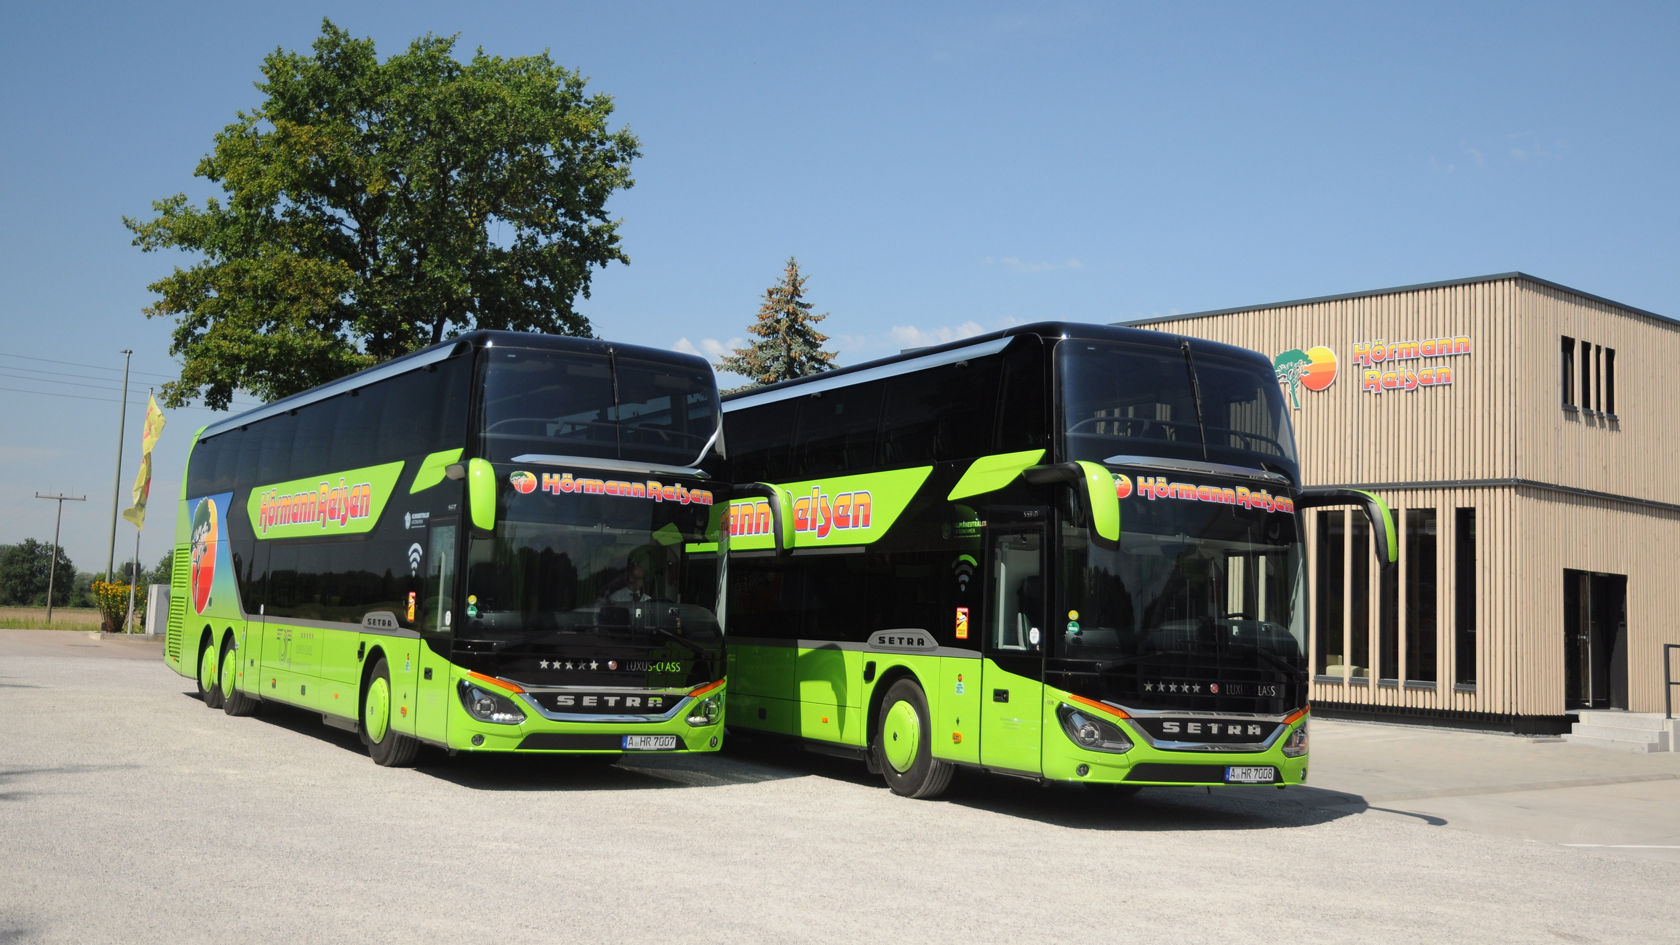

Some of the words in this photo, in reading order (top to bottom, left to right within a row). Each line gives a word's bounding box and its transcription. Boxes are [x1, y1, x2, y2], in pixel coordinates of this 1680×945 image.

[1352, 335, 1471, 367] Hörmann
[1363, 365, 1452, 394] Reisen
[542, 472, 646, 498] Hörmann
[647, 480, 713, 505] Reisen
[1137, 475, 1236, 505] Hörmann
[1236, 486, 1295, 514] Reisen
[259, 488, 318, 534] Hörmann
[317, 478, 371, 529] Reisen
[785, 485, 872, 539] eisen
[367, 618, 392, 627] SETRA
[878, 636, 925, 646] SETRA
[556, 695, 663, 707] SETRA
[1162, 721, 1261, 735] SETRA
